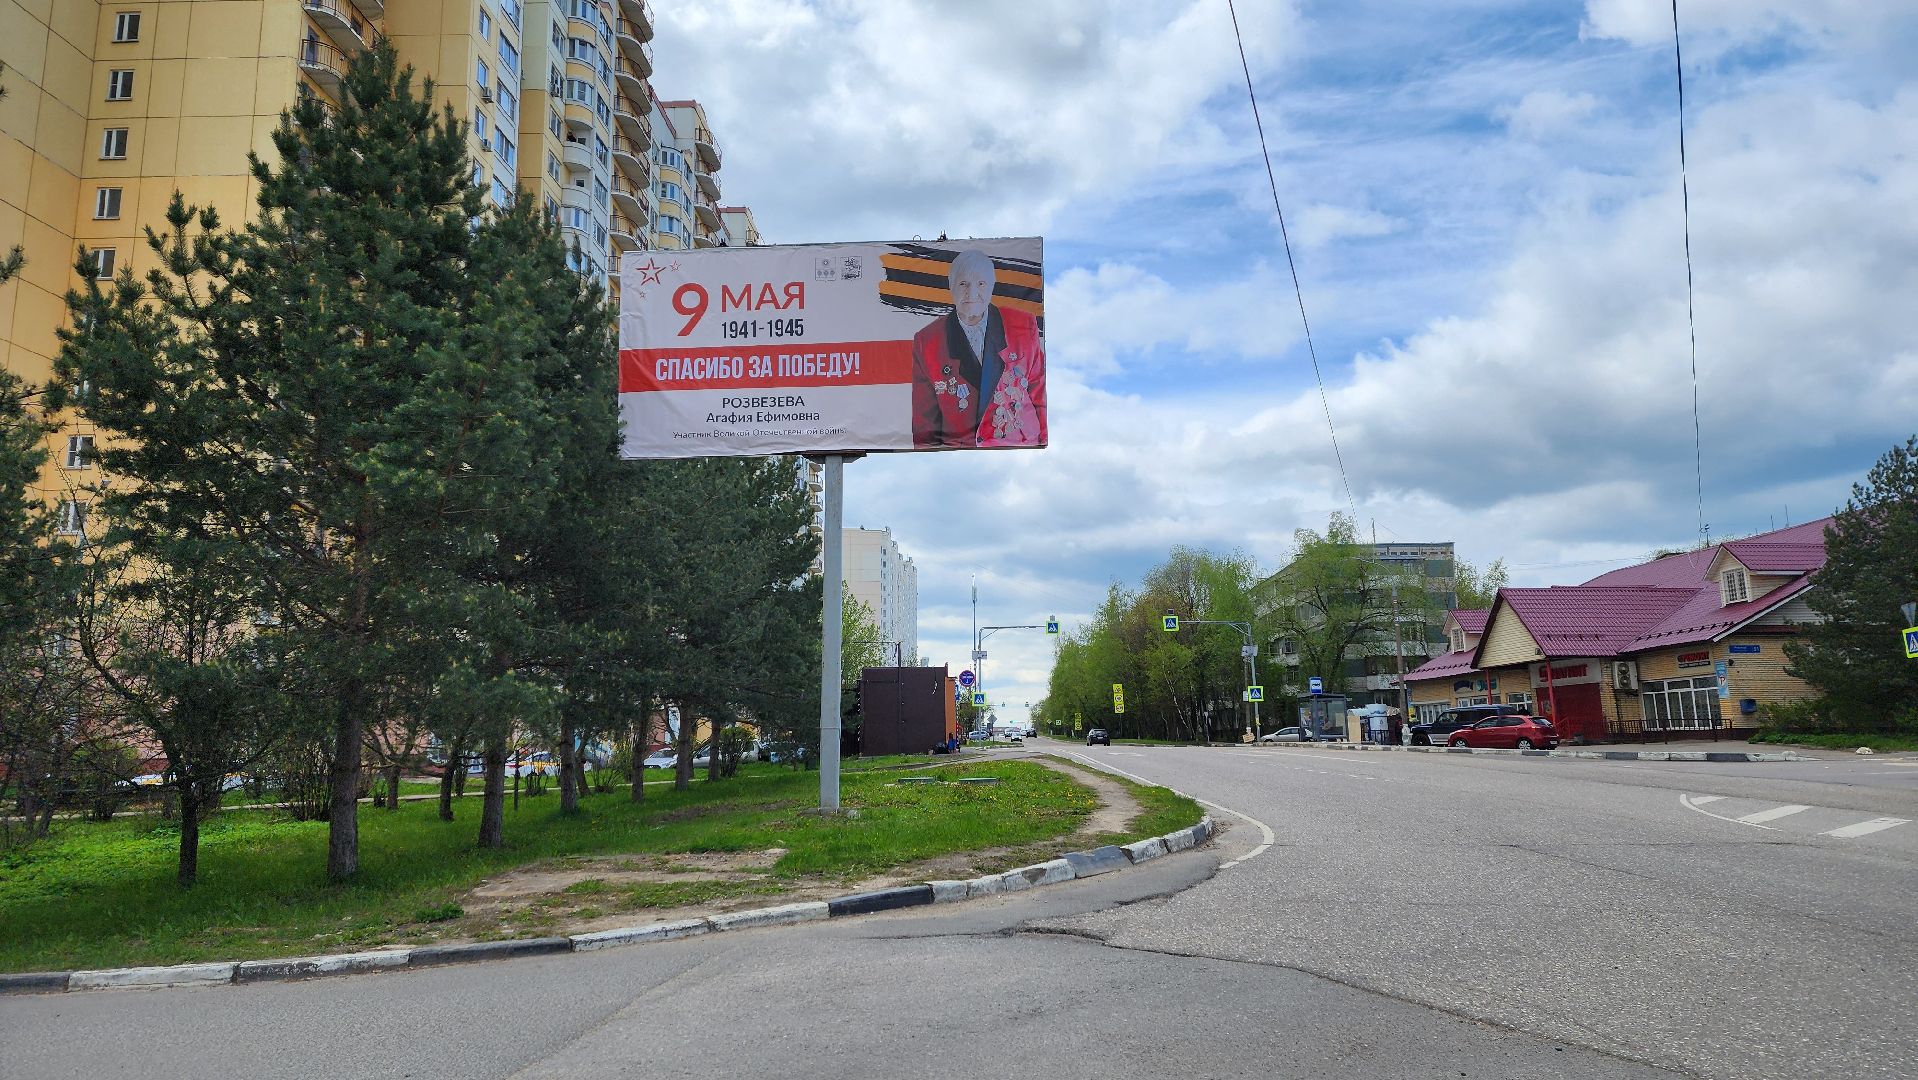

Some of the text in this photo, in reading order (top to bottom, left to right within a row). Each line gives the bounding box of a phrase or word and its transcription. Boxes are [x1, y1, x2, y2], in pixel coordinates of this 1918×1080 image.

[672, 281, 805, 336] 9 МАЯ
[721, 318, 804, 339] 1941-1945
[655, 352, 860, 381] СПАСИБО ЗА ПОБЕДУ!
[722, 396, 805, 409] РОЗВЕЗЕВА
[706, 411, 820, 425] Агафия Ефимовна
[672, 431, 712, 439] Участник
